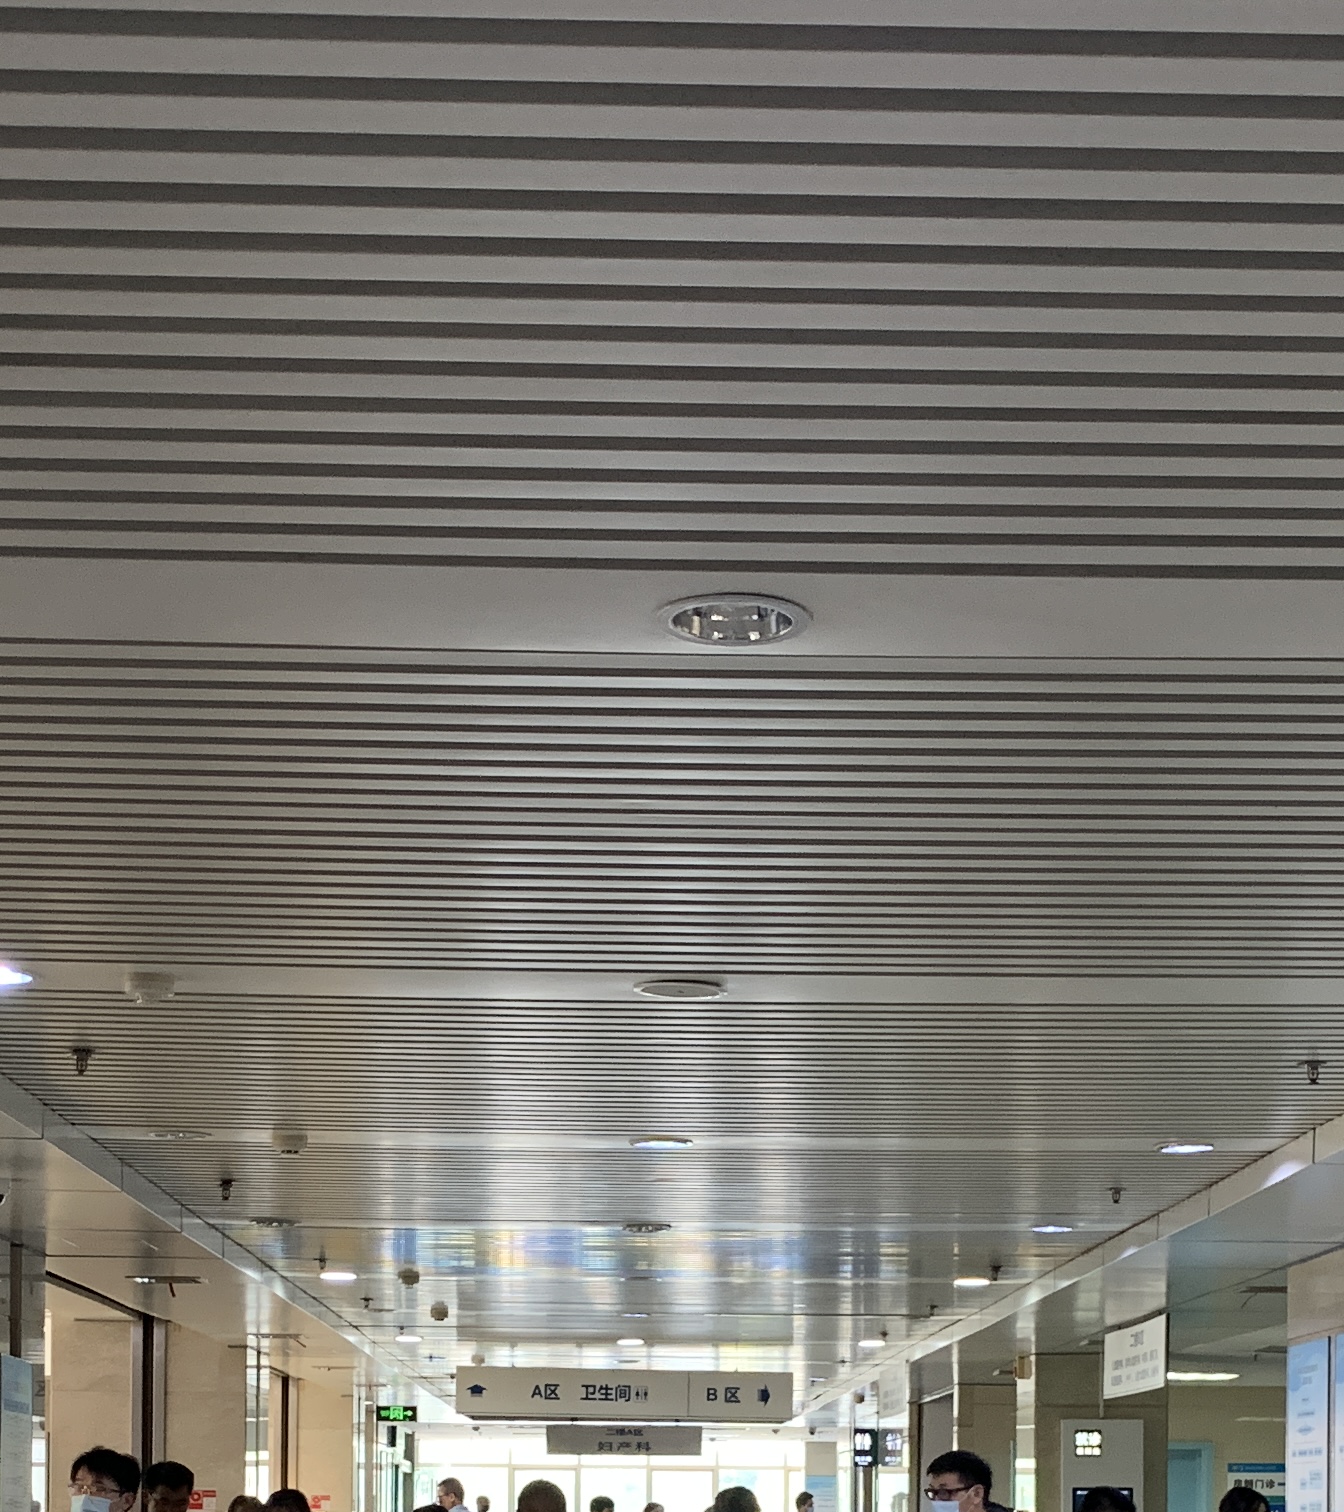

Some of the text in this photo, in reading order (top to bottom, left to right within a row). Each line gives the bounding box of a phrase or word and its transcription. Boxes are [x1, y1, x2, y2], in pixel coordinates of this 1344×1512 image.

[531, 1384, 631, 1402] A区 卫生间
[597, 1441, 652, 1452] 妇产科
